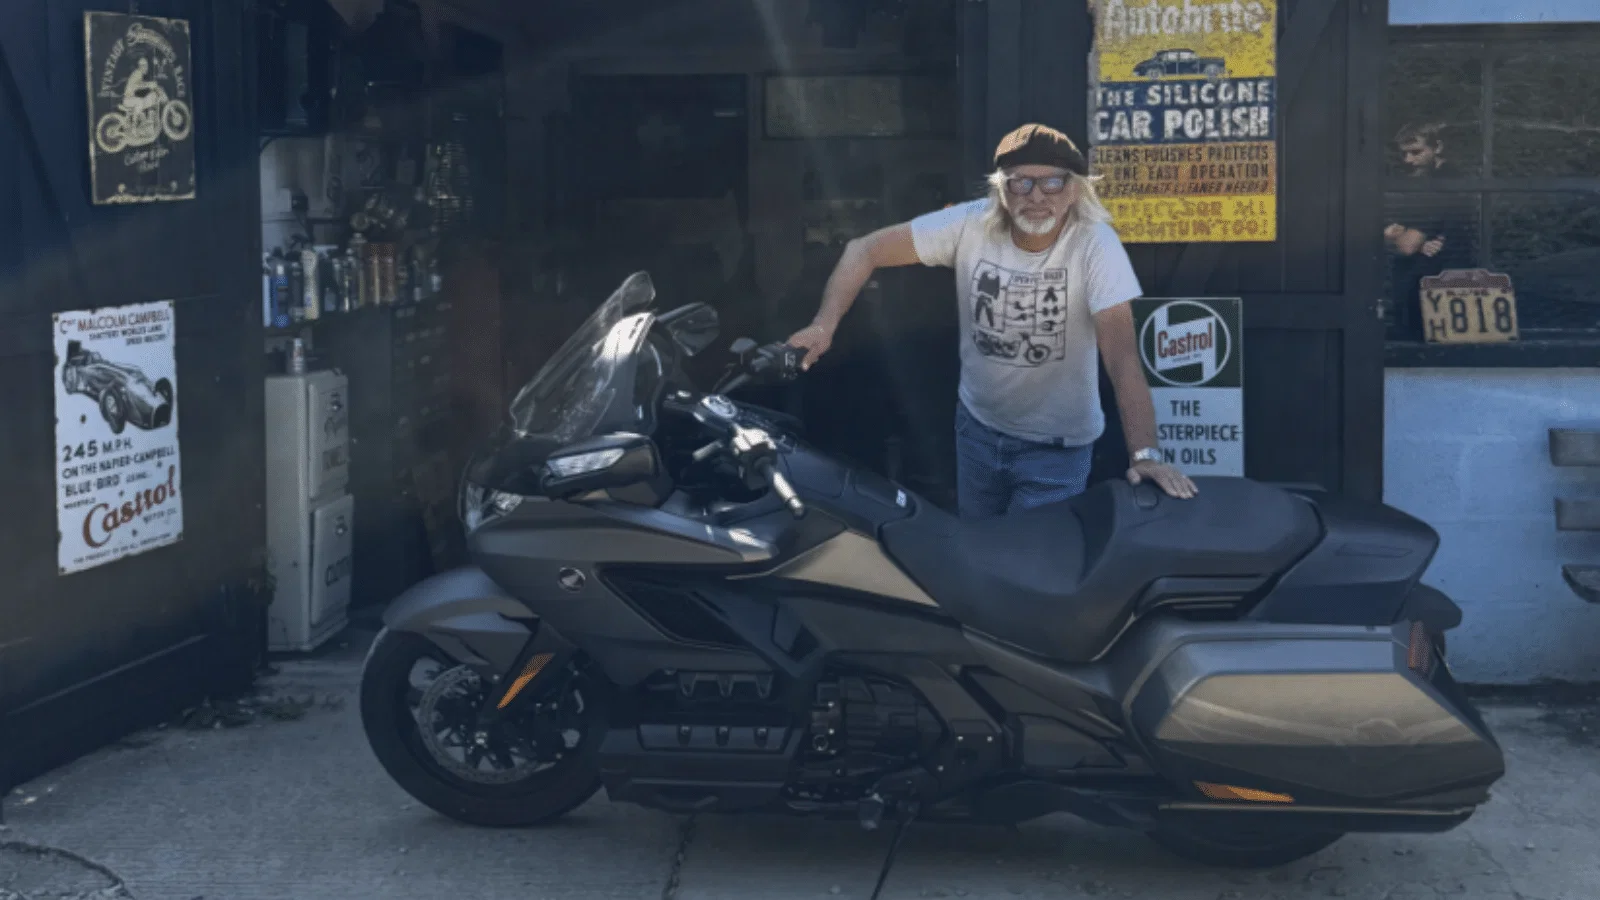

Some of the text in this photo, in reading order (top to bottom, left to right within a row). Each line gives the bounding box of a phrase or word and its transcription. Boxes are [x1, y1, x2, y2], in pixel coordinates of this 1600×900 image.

[1146, 81, 1269, 106] SILICONE
[1095, 106, 1269, 140] CAR POLISH
[1144, 147, 1203, 162] POLISHES
[1209, 145, 1268, 161] PROTECTS
[1148, 165, 1179, 179] EASY
[1190, 163, 1268, 179] OPERATION
[1450, 297, 1513, 333] 818
[1157, 322, 1213, 359] Castrol
[1170, 400, 1201, 417] THE
[1158, 425, 1239, 442] STERPIECE
[62, 439, 98, 463] 245
[1181, 448, 1217, 465] OILS
[62, 467, 79, 479] ON
[80, 461, 97, 475] THE
[82, 464, 177, 549] Castrol
